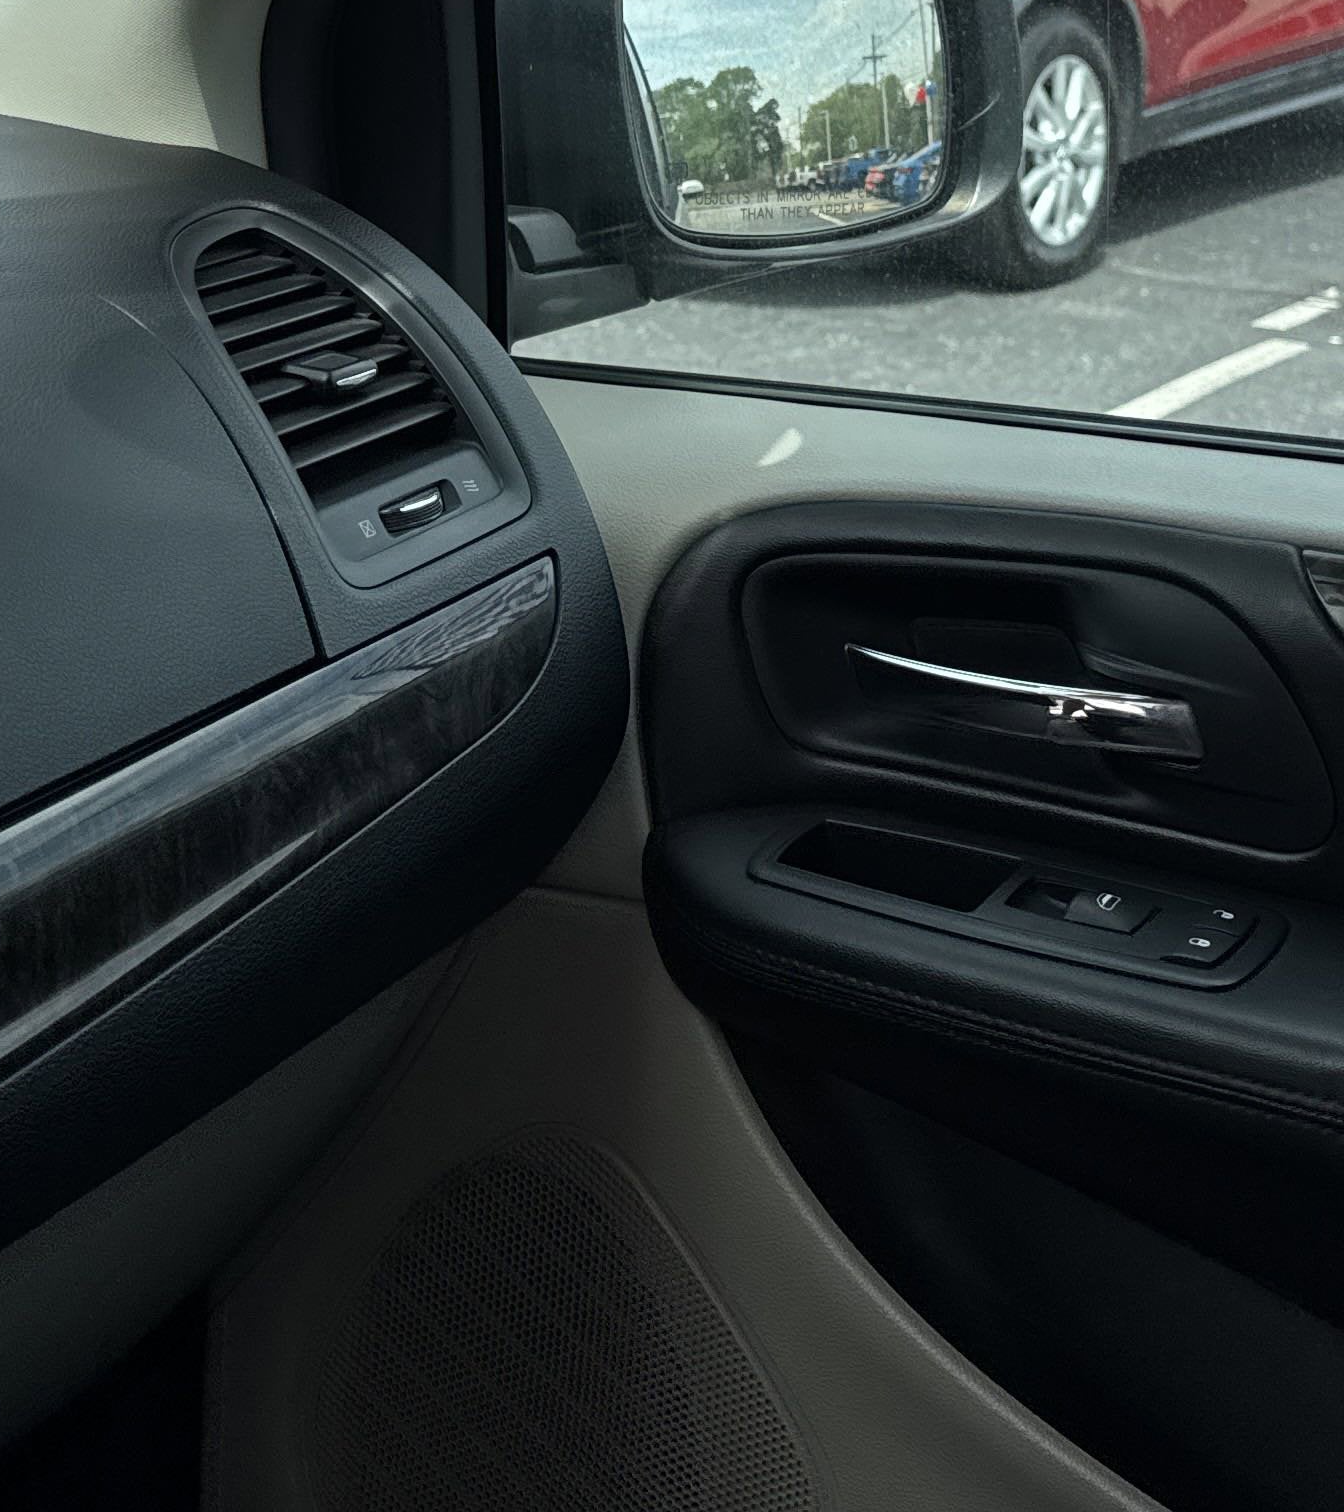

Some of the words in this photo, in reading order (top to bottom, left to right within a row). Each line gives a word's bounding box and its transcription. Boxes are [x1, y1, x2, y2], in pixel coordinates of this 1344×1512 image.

[695, 191, 751, 206] OBJECTS
[757, 191, 769, 204] IN
[776, 190, 821, 203] MIRROR
[740, 207, 774, 220] THAN
[780, 205, 812, 219] THEY
[818, 202, 865, 217] APPEAR
